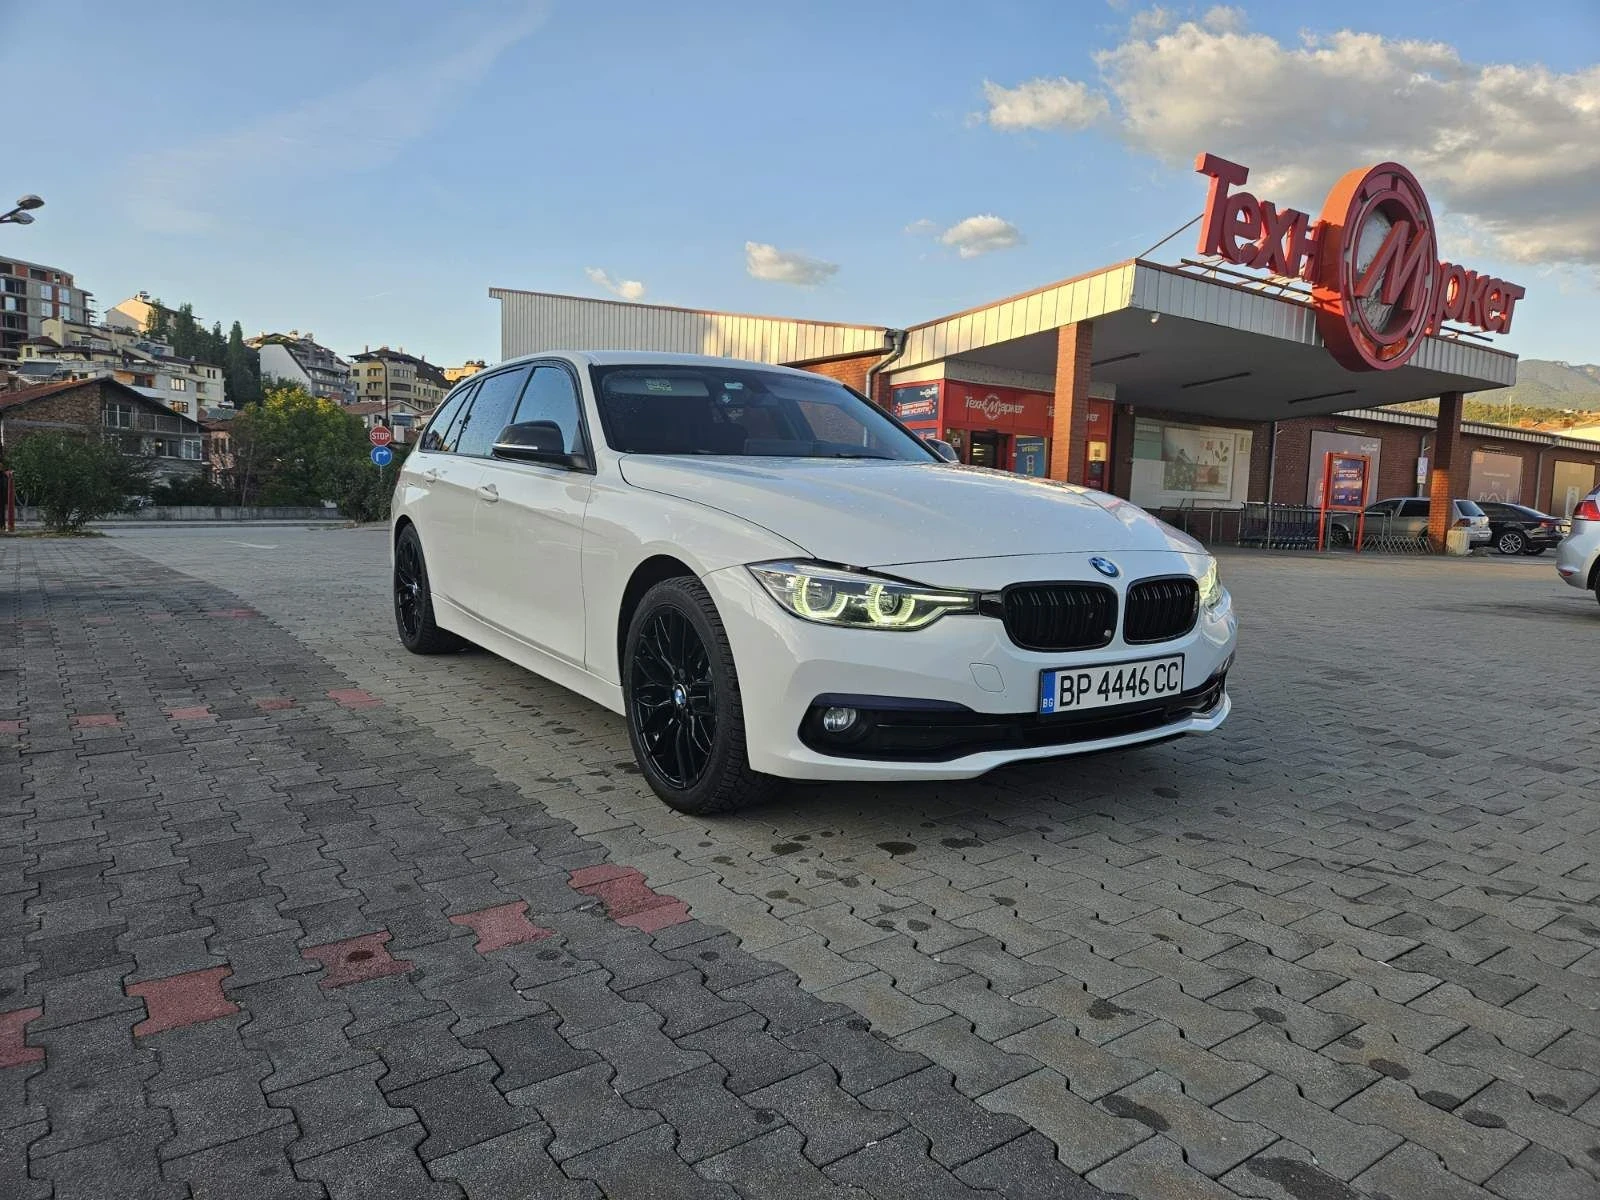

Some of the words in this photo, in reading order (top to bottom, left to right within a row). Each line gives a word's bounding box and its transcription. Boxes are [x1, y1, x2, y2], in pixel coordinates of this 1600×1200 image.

[371, 432, 390, 440] STOP
[1059, 673, 1092, 707] BP
[1097, 666, 1150, 702] 4446
[1154, 661, 1179, 693] CC
[1042, 697, 1054, 708] BG
